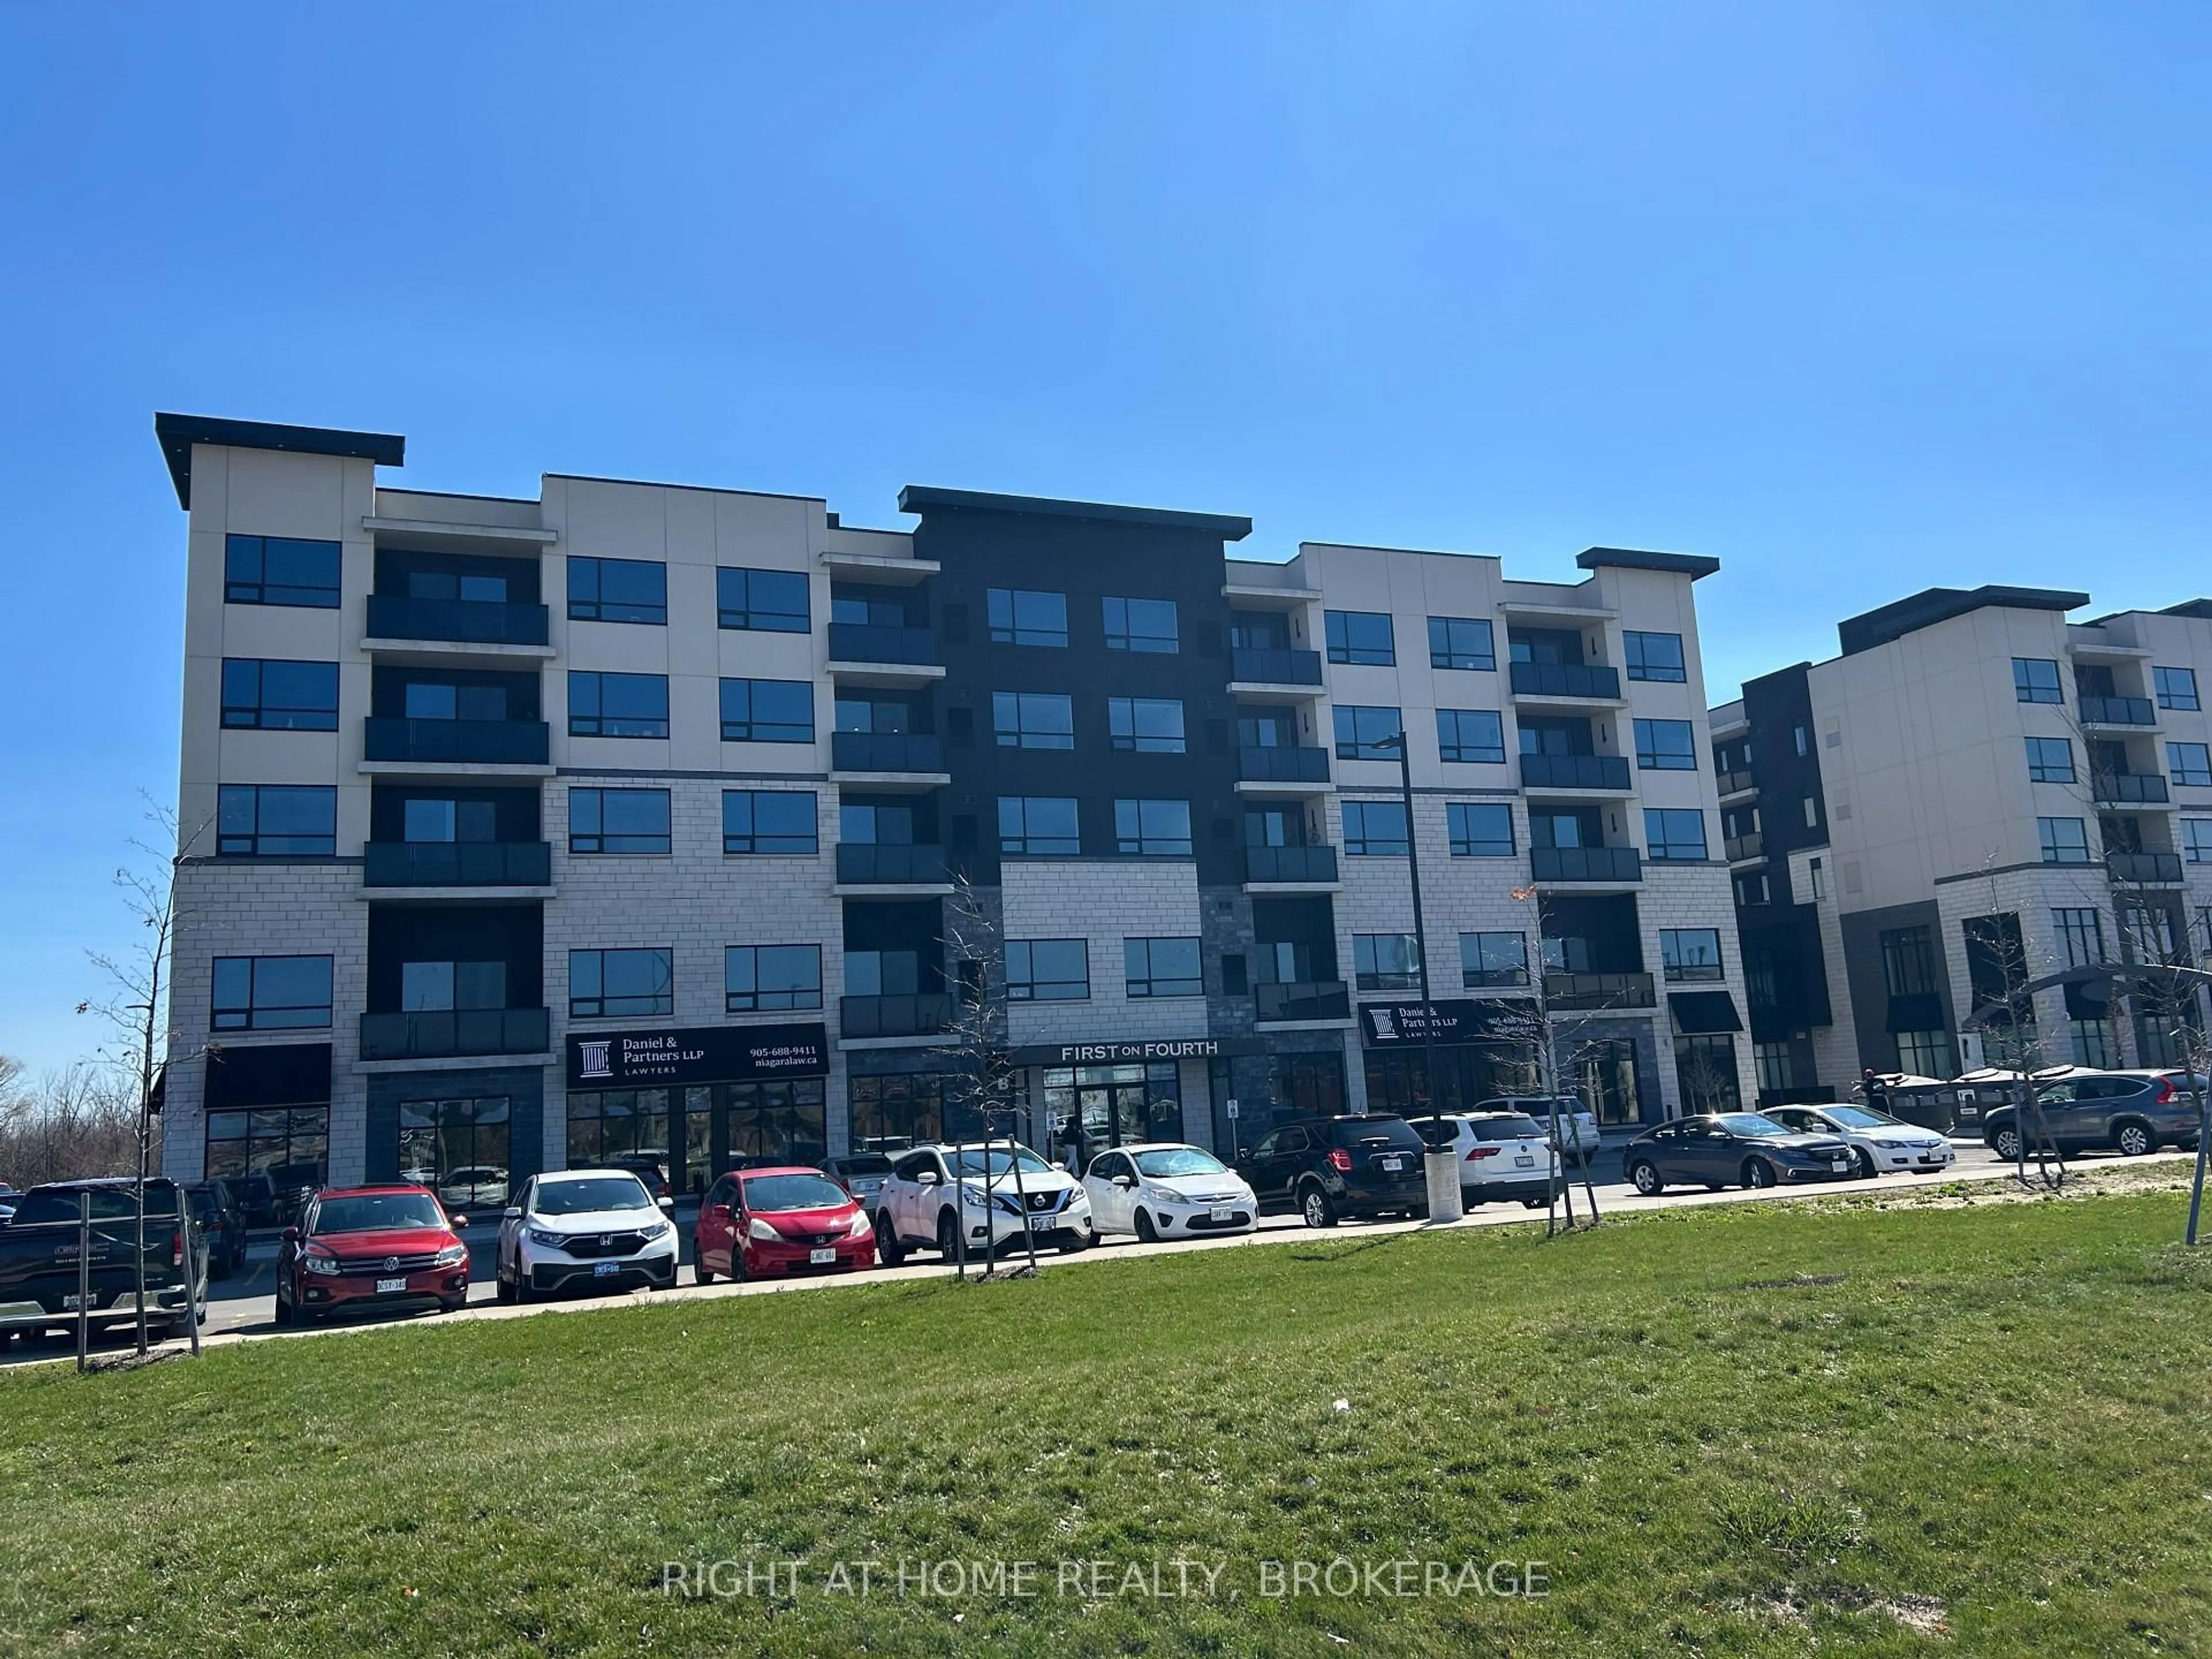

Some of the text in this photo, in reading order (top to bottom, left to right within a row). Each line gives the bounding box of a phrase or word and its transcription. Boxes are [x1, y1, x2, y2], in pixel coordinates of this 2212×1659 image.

[1399, 1007, 1437, 1017] Danie &
[1442, 1018, 1457, 1026] LLP
[623, 1037, 677, 1050] Daniel &
[750, 1046, 816, 1057] 905-688-9411
[1062, 1041, 1218, 1061] FIRST ON FOURTH
[624, 1051, 704, 1063] Partners LLP
[756, 1056, 817, 1068] niagaralaw.ca
[625, 1067, 676, 1075] LAWYERS
